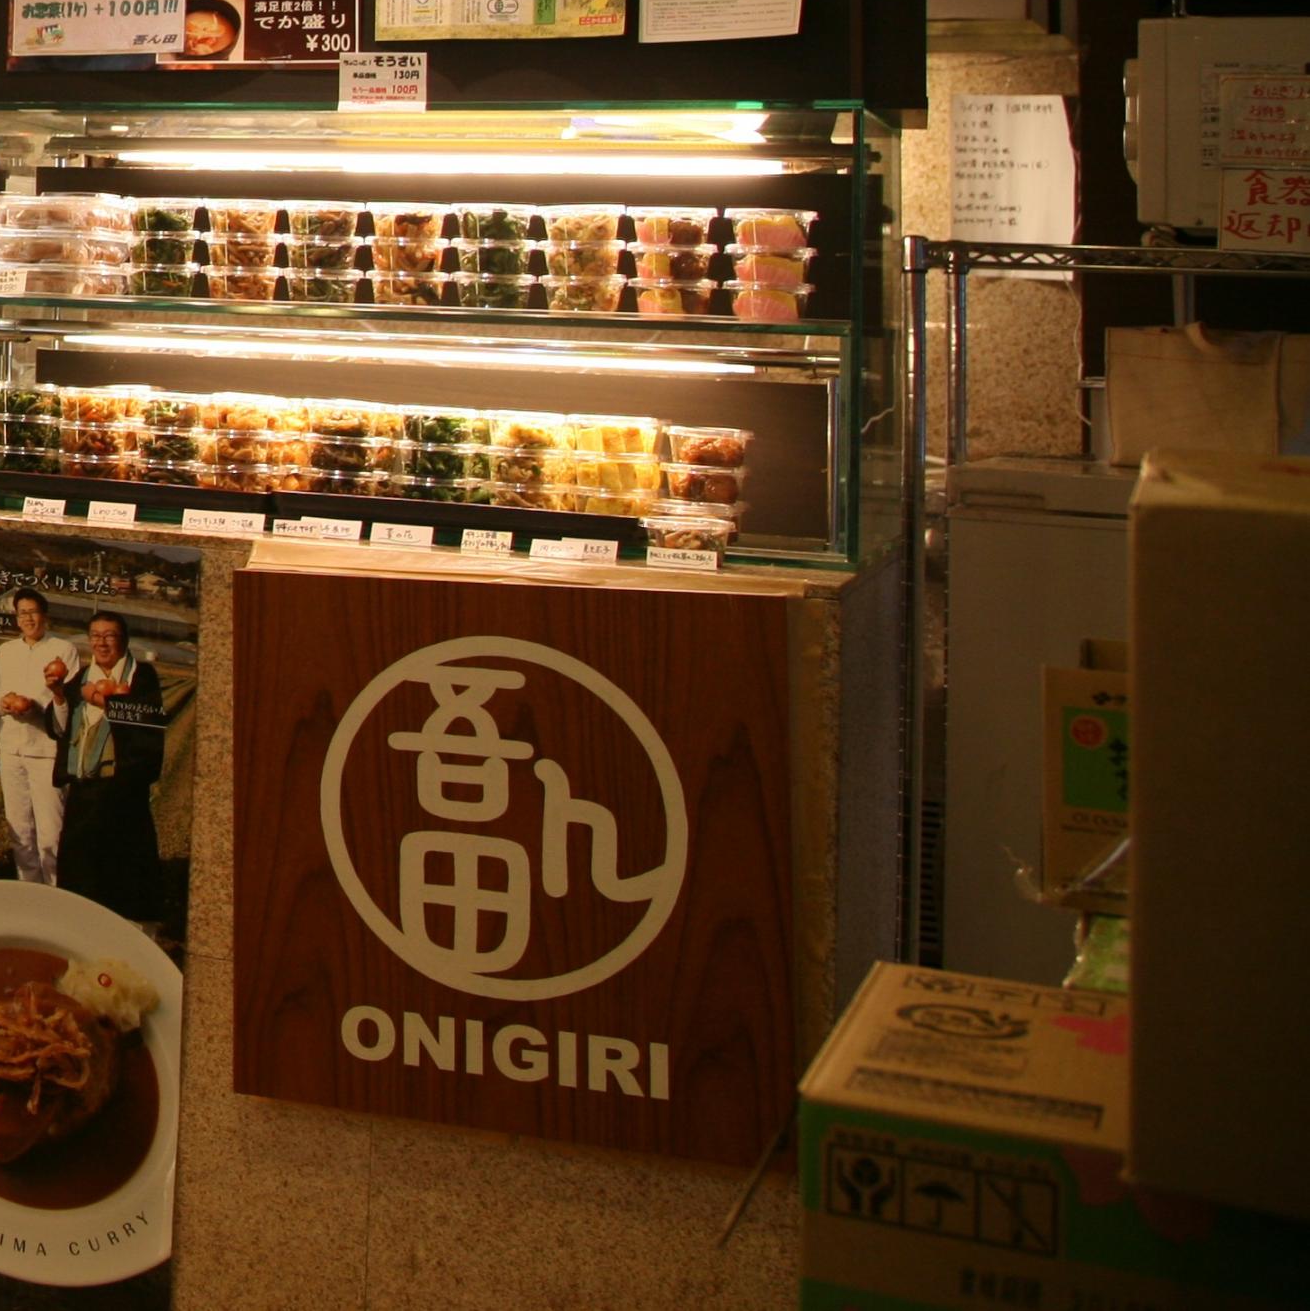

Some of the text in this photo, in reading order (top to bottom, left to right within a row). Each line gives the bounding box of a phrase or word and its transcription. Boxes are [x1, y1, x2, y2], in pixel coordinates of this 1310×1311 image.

[254, 13, 346, 30] でか盛り
[305, 33, 351, 52] ¥300
[374, 56, 421, 67] そうざい
[393, 70, 420, 80] 130円
[392, 85, 418, 94] 100円
[1224, 210, 1310, 244] 返却
[340, 1005, 670, 1101] ONIGIRI
[69, 1211, 149, 1257] CURRY
